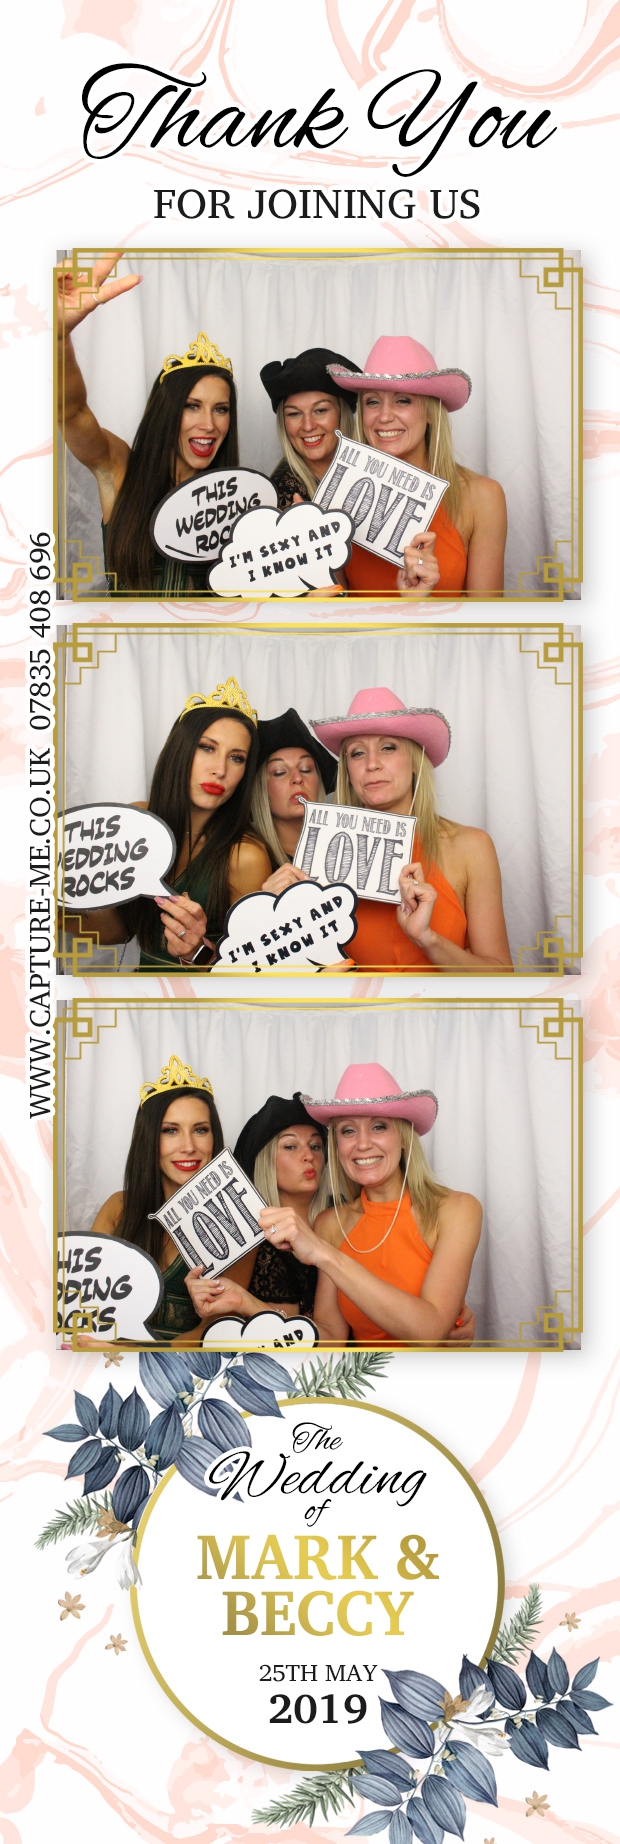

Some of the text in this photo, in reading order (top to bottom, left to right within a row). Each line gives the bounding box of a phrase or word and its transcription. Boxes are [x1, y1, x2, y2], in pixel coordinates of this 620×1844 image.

[191, 477, 238, 506] THIS
[339, 446, 436, 501] ALL YOU NEED IS
[176, 493, 261, 537] WEDDING
[319, 463, 427, 558] LOVE
[196, 525, 234, 554] ROC
[229, 521, 341, 568] I'M SEXY AND
[248, 543, 333, 582] I KNOW IT
[64, 815, 121, 843] THIS
[309, 809, 407, 837] ALL YOU NEED IS
[58, 838, 149, 871] EDDING
[301, 826, 403, 896] LOVE
[61, 867, 135, 898] ROCKS
[228, 896, 343, 963] I'M SEXY AND
[266, 933, 314, 966] KNOW
[319, 919, 338, 939] IT
[162, 1160, 234, 1229] ALL YOU NEED IS
[172, 1176, 264, 1277] LOVE
[57, 1246, 102, 1273] HIS
[273, 1329, 303, 1348] AND
